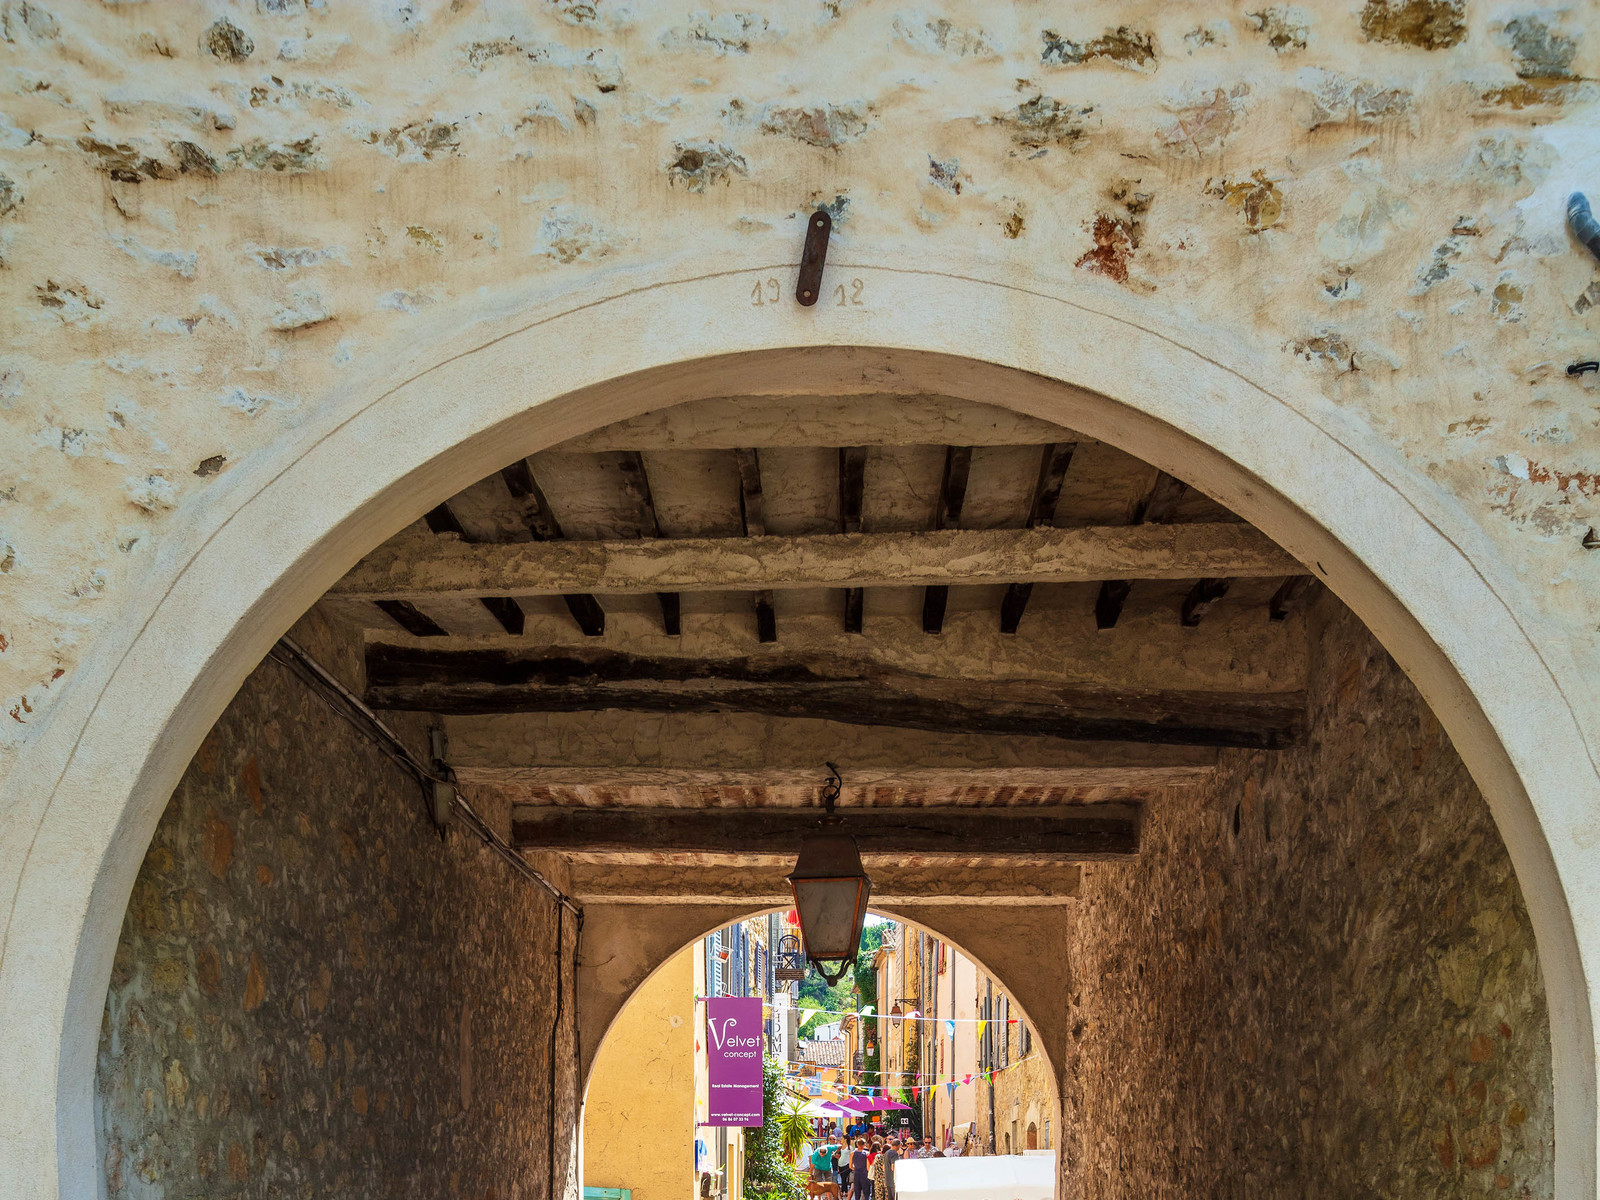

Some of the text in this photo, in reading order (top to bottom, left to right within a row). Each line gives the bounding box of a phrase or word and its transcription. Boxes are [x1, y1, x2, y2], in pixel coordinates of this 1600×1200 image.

[751, 277, 864, 307] 19 12
[708, 1017, 761, 1051] Velvet
[723, 1050, 757, 1059] concept
